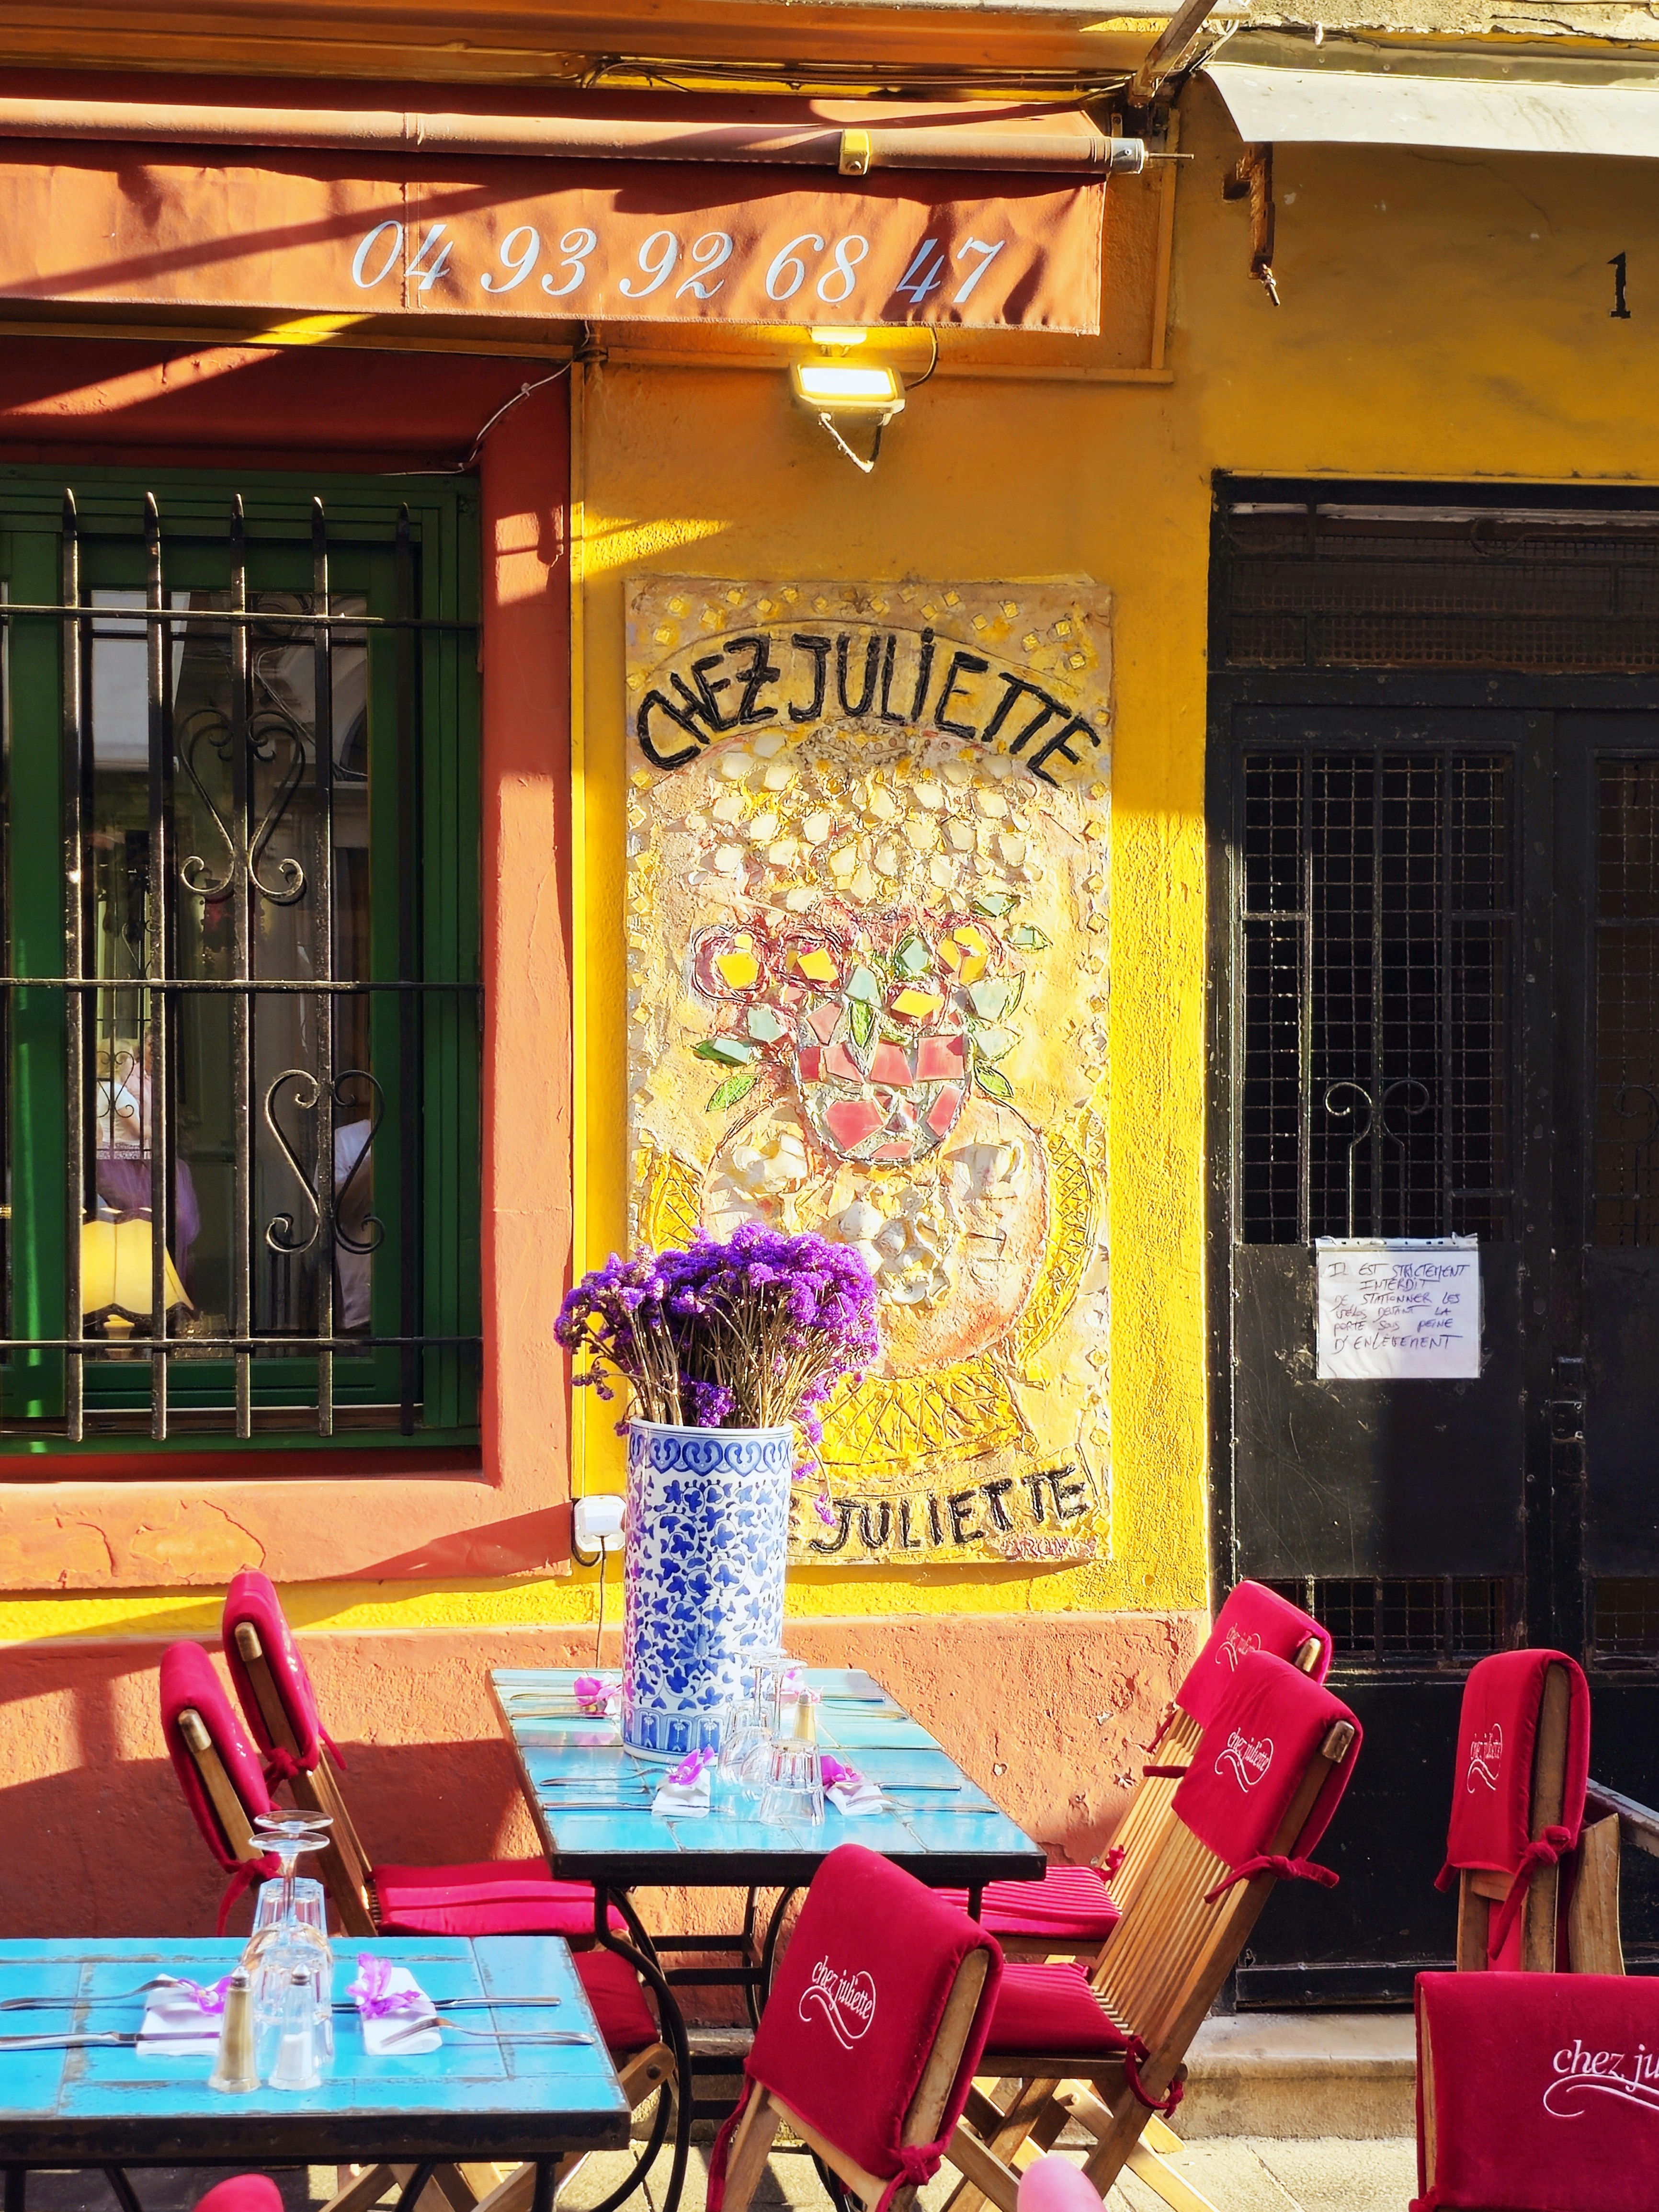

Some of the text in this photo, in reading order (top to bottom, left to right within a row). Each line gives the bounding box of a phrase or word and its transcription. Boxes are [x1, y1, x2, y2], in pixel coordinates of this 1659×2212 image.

[352, 220, 1005, 303] 04 93 92 68 47
[1607, 251, 1631, 319] 1
[636, 634, 781, 771] CHEZ
[1329, 1262, 1349, 1277] IL
[1359, 1263, 1389, 1276] EST
[1330, 1292, 1460, 1312] DE STATIONNER LES
[1434, 1307, 1452, 1315] LA
[808, 1462, 1090, 1554] JULIETTE
[812, 1955, 873, 2019] chez juliette
[1553, 2039, 1625, 2081] chez
